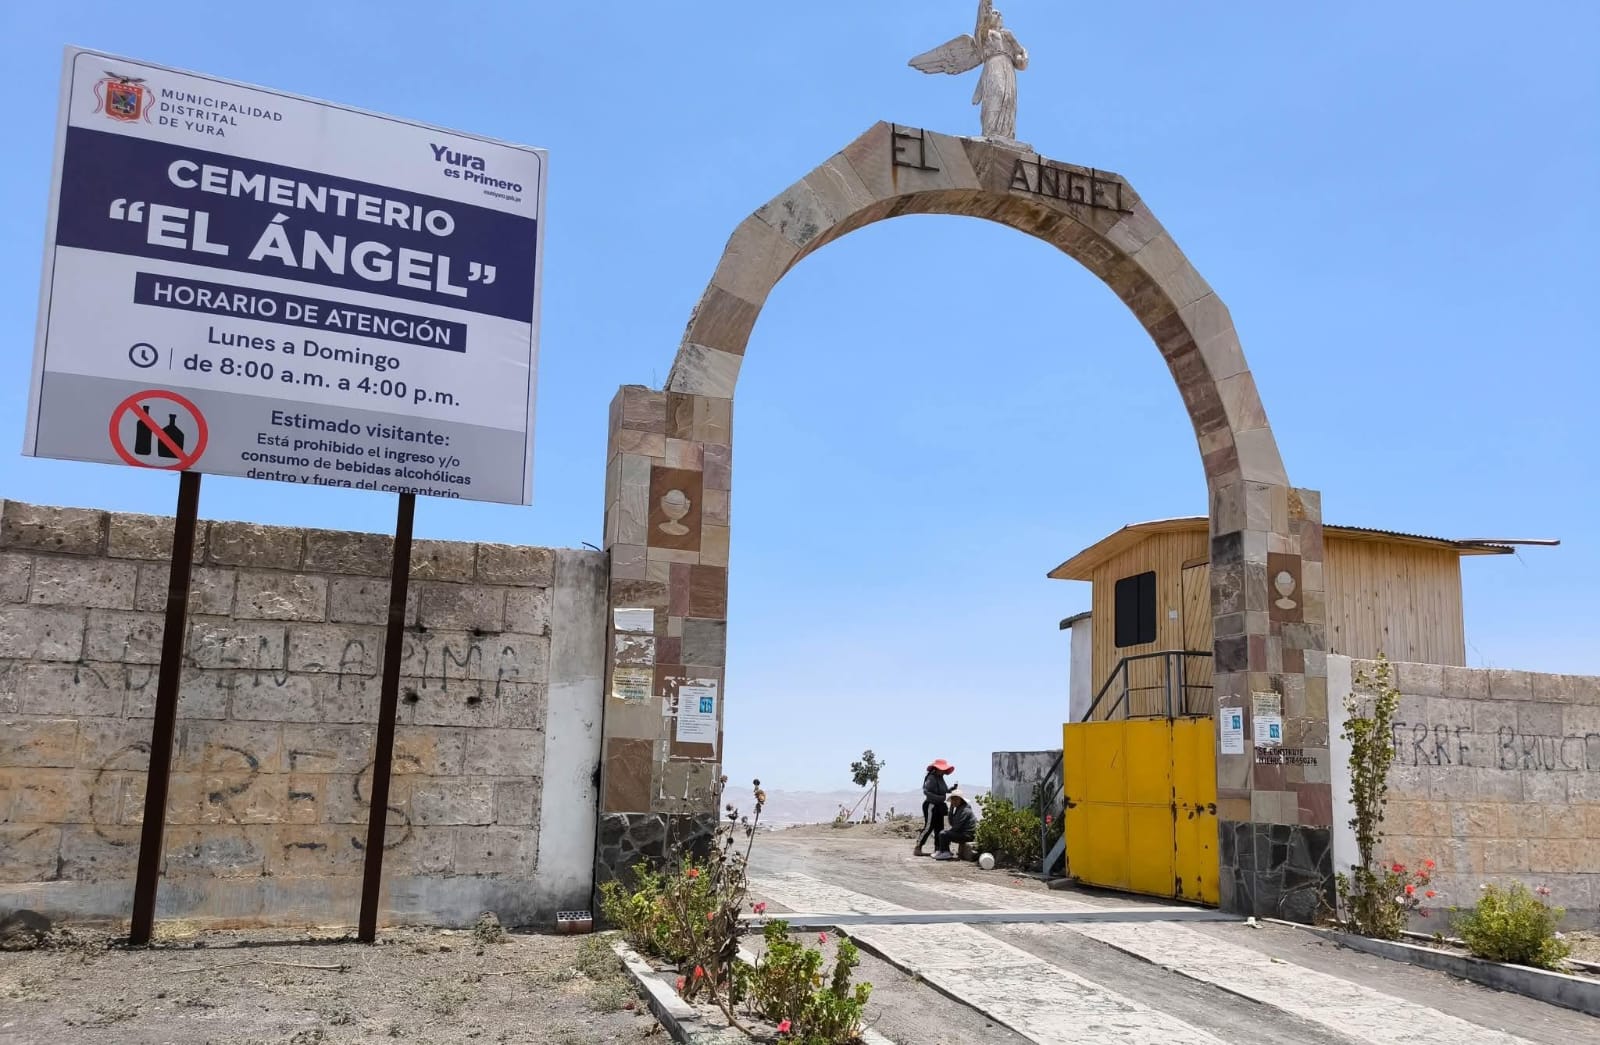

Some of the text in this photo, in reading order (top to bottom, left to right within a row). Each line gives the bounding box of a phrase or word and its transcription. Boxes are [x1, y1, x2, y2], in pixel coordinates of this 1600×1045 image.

[160, 102, 238, 126] DISTRITAL
[161, 88, 283, 122] MUNICIPALIDAD
[159, 115, 226, 137] DE YURA
[430, 143, 486, 172] Yura
[891, 123, 1134, 215] EL ANGEL
[167, 158, 456, 237] CEMENTERIO
[443, 168, 523, 193] es Primero
[108, 198, 497, 298] “EL ÁNGEL”
[153, 282, 451, 345] HORARIO DE ATENCIÓN
[207, 326, 401, 372] Lunes a Domingo
[183, 353, 460, 407] de 8:00 a.m. a 4:00 p.m.
[270, 409, 450, 447] Estimado visitante:
[240, 451, 472, 486] consumo de bebidas alcohólicas
[256, 432, 461, 469] Está prohibido el ingreso y/o
[246, 467, 297, 484] dentro
[312, 474, 352, 489] fuera
[355, 478, 378, 491] del
